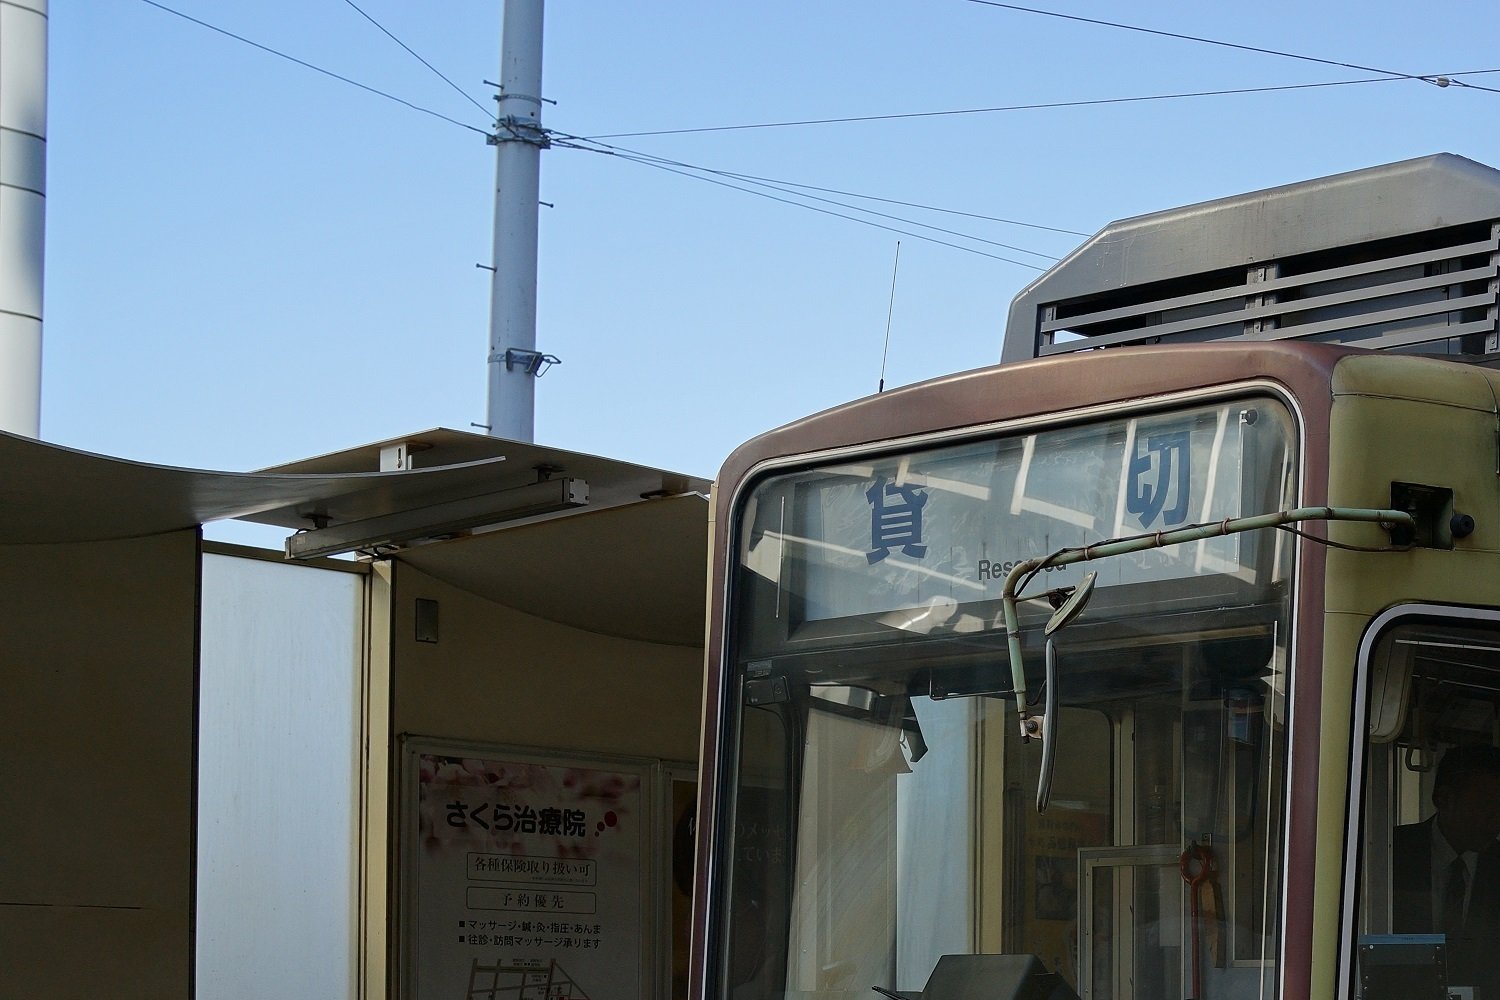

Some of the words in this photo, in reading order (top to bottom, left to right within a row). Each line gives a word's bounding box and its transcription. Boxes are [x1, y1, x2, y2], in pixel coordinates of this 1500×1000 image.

[446, 801, 586, 837] さくら治療院
[475, 857, 591, 877] 各種保険取り扱い可
[502, 892, 564, 909] 予約優先
